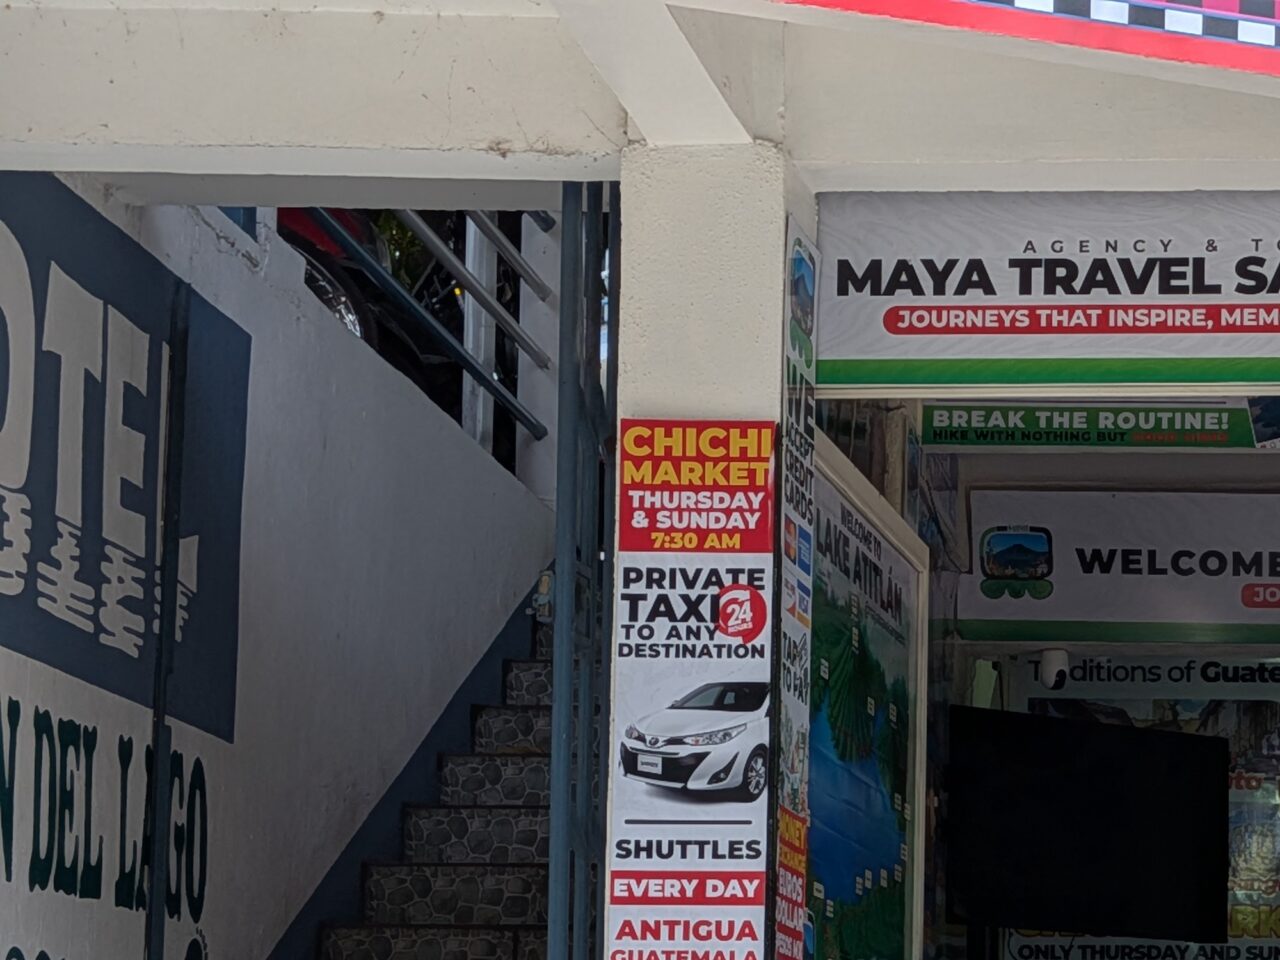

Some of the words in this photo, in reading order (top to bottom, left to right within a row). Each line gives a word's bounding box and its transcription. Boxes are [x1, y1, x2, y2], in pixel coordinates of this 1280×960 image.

[1023, 239, 1174, 254] AGENCY
[1206, 239, 1219, 252] &
[836, 258, 997, 296] MAYA
[1009, 257, 1222, 295] TRAVEL
[897, 310, 1029, 330] JOURNEYS
[1038, 309, 1101, 328] THAT
[1108, 308, 1214, 330] INSPIRE,
[933, 410, 1026, 428] BREAK
[1035, 411, 1088, 429] THE
[1099, 412, 1229, 430] ROUTINE!
[623, 426, 772, 458] CHICHI
[932, 430, 968, 441] HIKE
[974, 430, 1015, 441] WITH
[1021, 431, 1090, 442] NOTHING
[1097, 432, 1126, 442] BUT
[623, 461, 769, 486] MARKET
[628, 490, 765, 510] THURSDAY
[631, 511, 649, 529] &
[656, 511, 761, 530] SUNDAY
[651, 533, 698, 549] 7:30
[704, 533, 741, 549] AM
[840, 503, 872, 552] WELCOME
[873, 536, 881, 561] TO
[816, 508, 850, 579] LAKE
[854, 546, 902, 626] ATITLÁN
[623, 567, 765, 590] PRIVATE
[622, 593, 720, 623] TAXI
[622, 625, 655, 641] TO
[666, 624, 717, 641] ANY
[618, 643, 765, 659] DESTINATION
[1167, 661, 1197, 684] of
[29, 705, 103, 899] DEL
[615, 840, 762, 860] SHUTTLES
[613, 879, 700, 898] EVERY
[705, 879, 760, 897] DAY
[616, 920, 758, 942] ANTIGUA
[1018, 945, 1075, 960] ONLY
[1077, 945, 1189, 960] THURSDAY
[1194, 945, 1241, 960] AND
